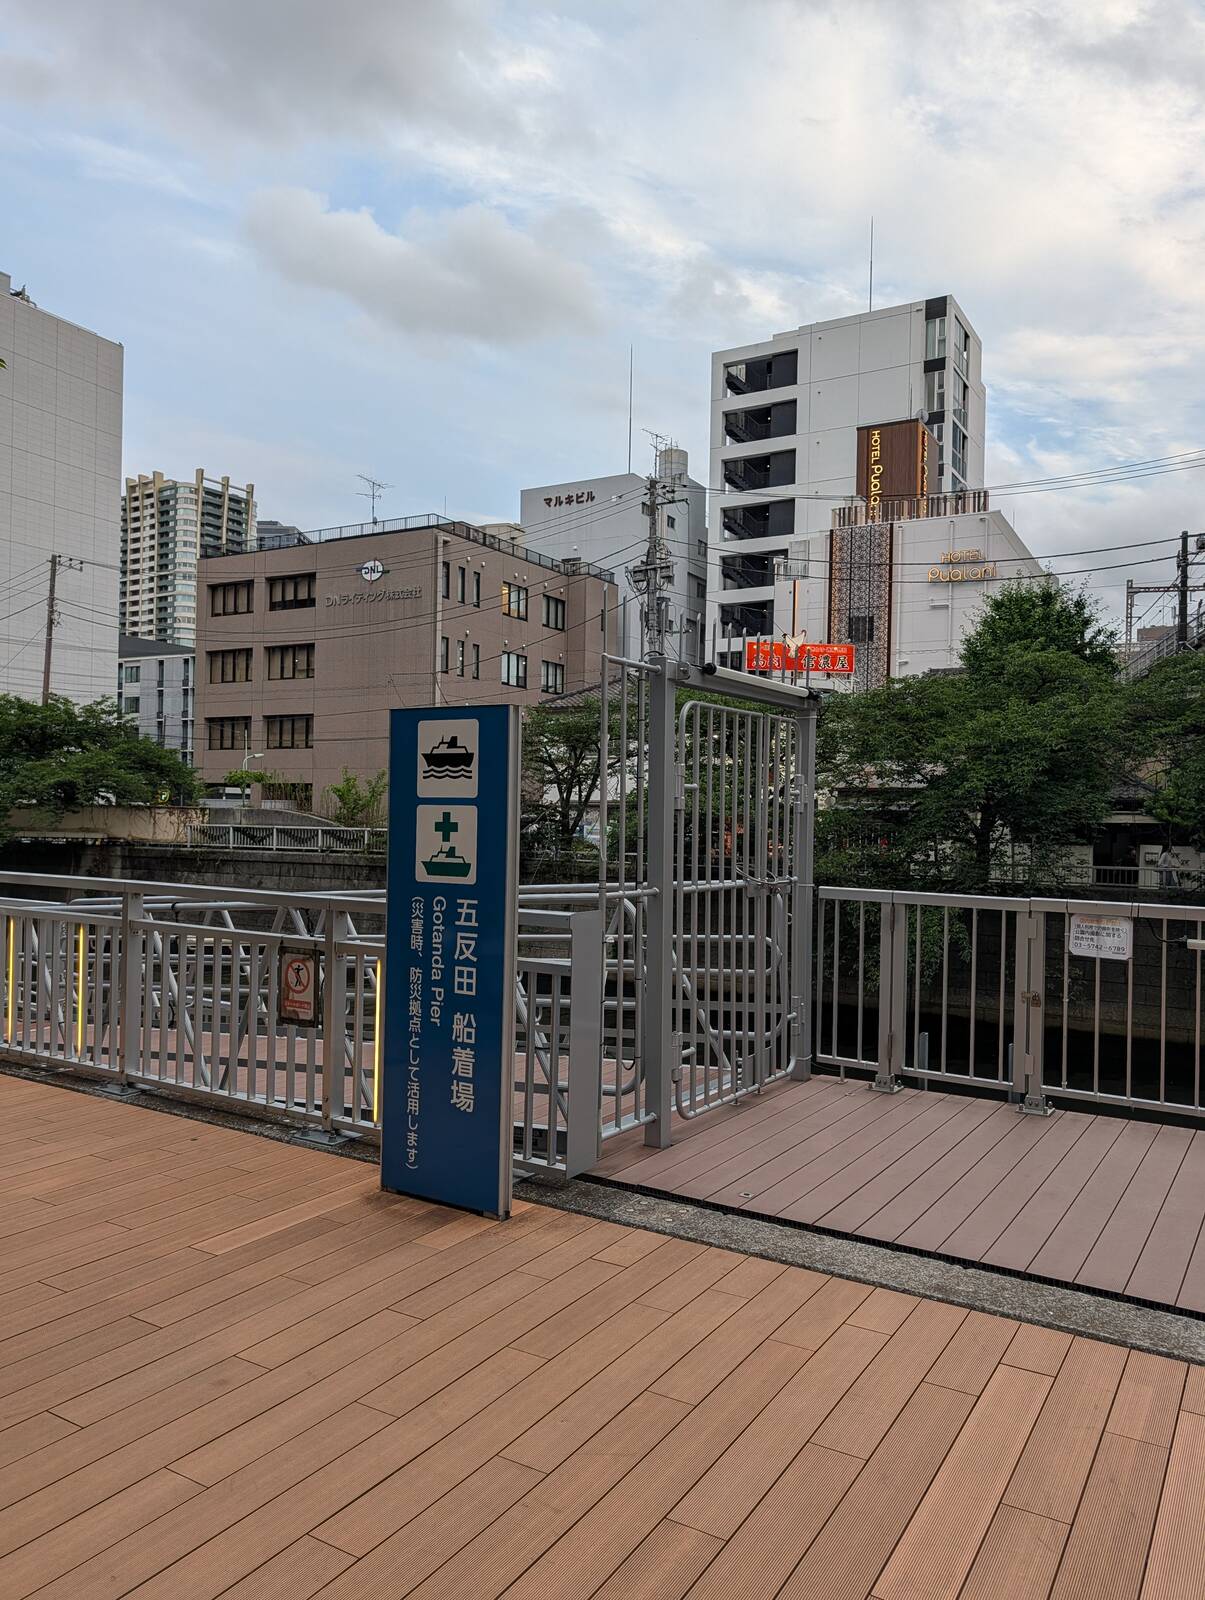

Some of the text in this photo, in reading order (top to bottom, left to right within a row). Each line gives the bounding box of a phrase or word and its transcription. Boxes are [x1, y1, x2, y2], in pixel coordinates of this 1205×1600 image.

[871, 430, 881, 464] HOTEL
[543, 490, 596, 508] マルキビル
[940, 549, 985, 563] HOTEL
[928, 561, 996, 582] Pualani
[325, 586, 422, 608] DNライティング株式会社
[801, 653, 849, 670] 信濃屋
[430, 895, 447, 1027] Gotanda Pier
[450, 898, 479, 1113] 五反田 船着場
